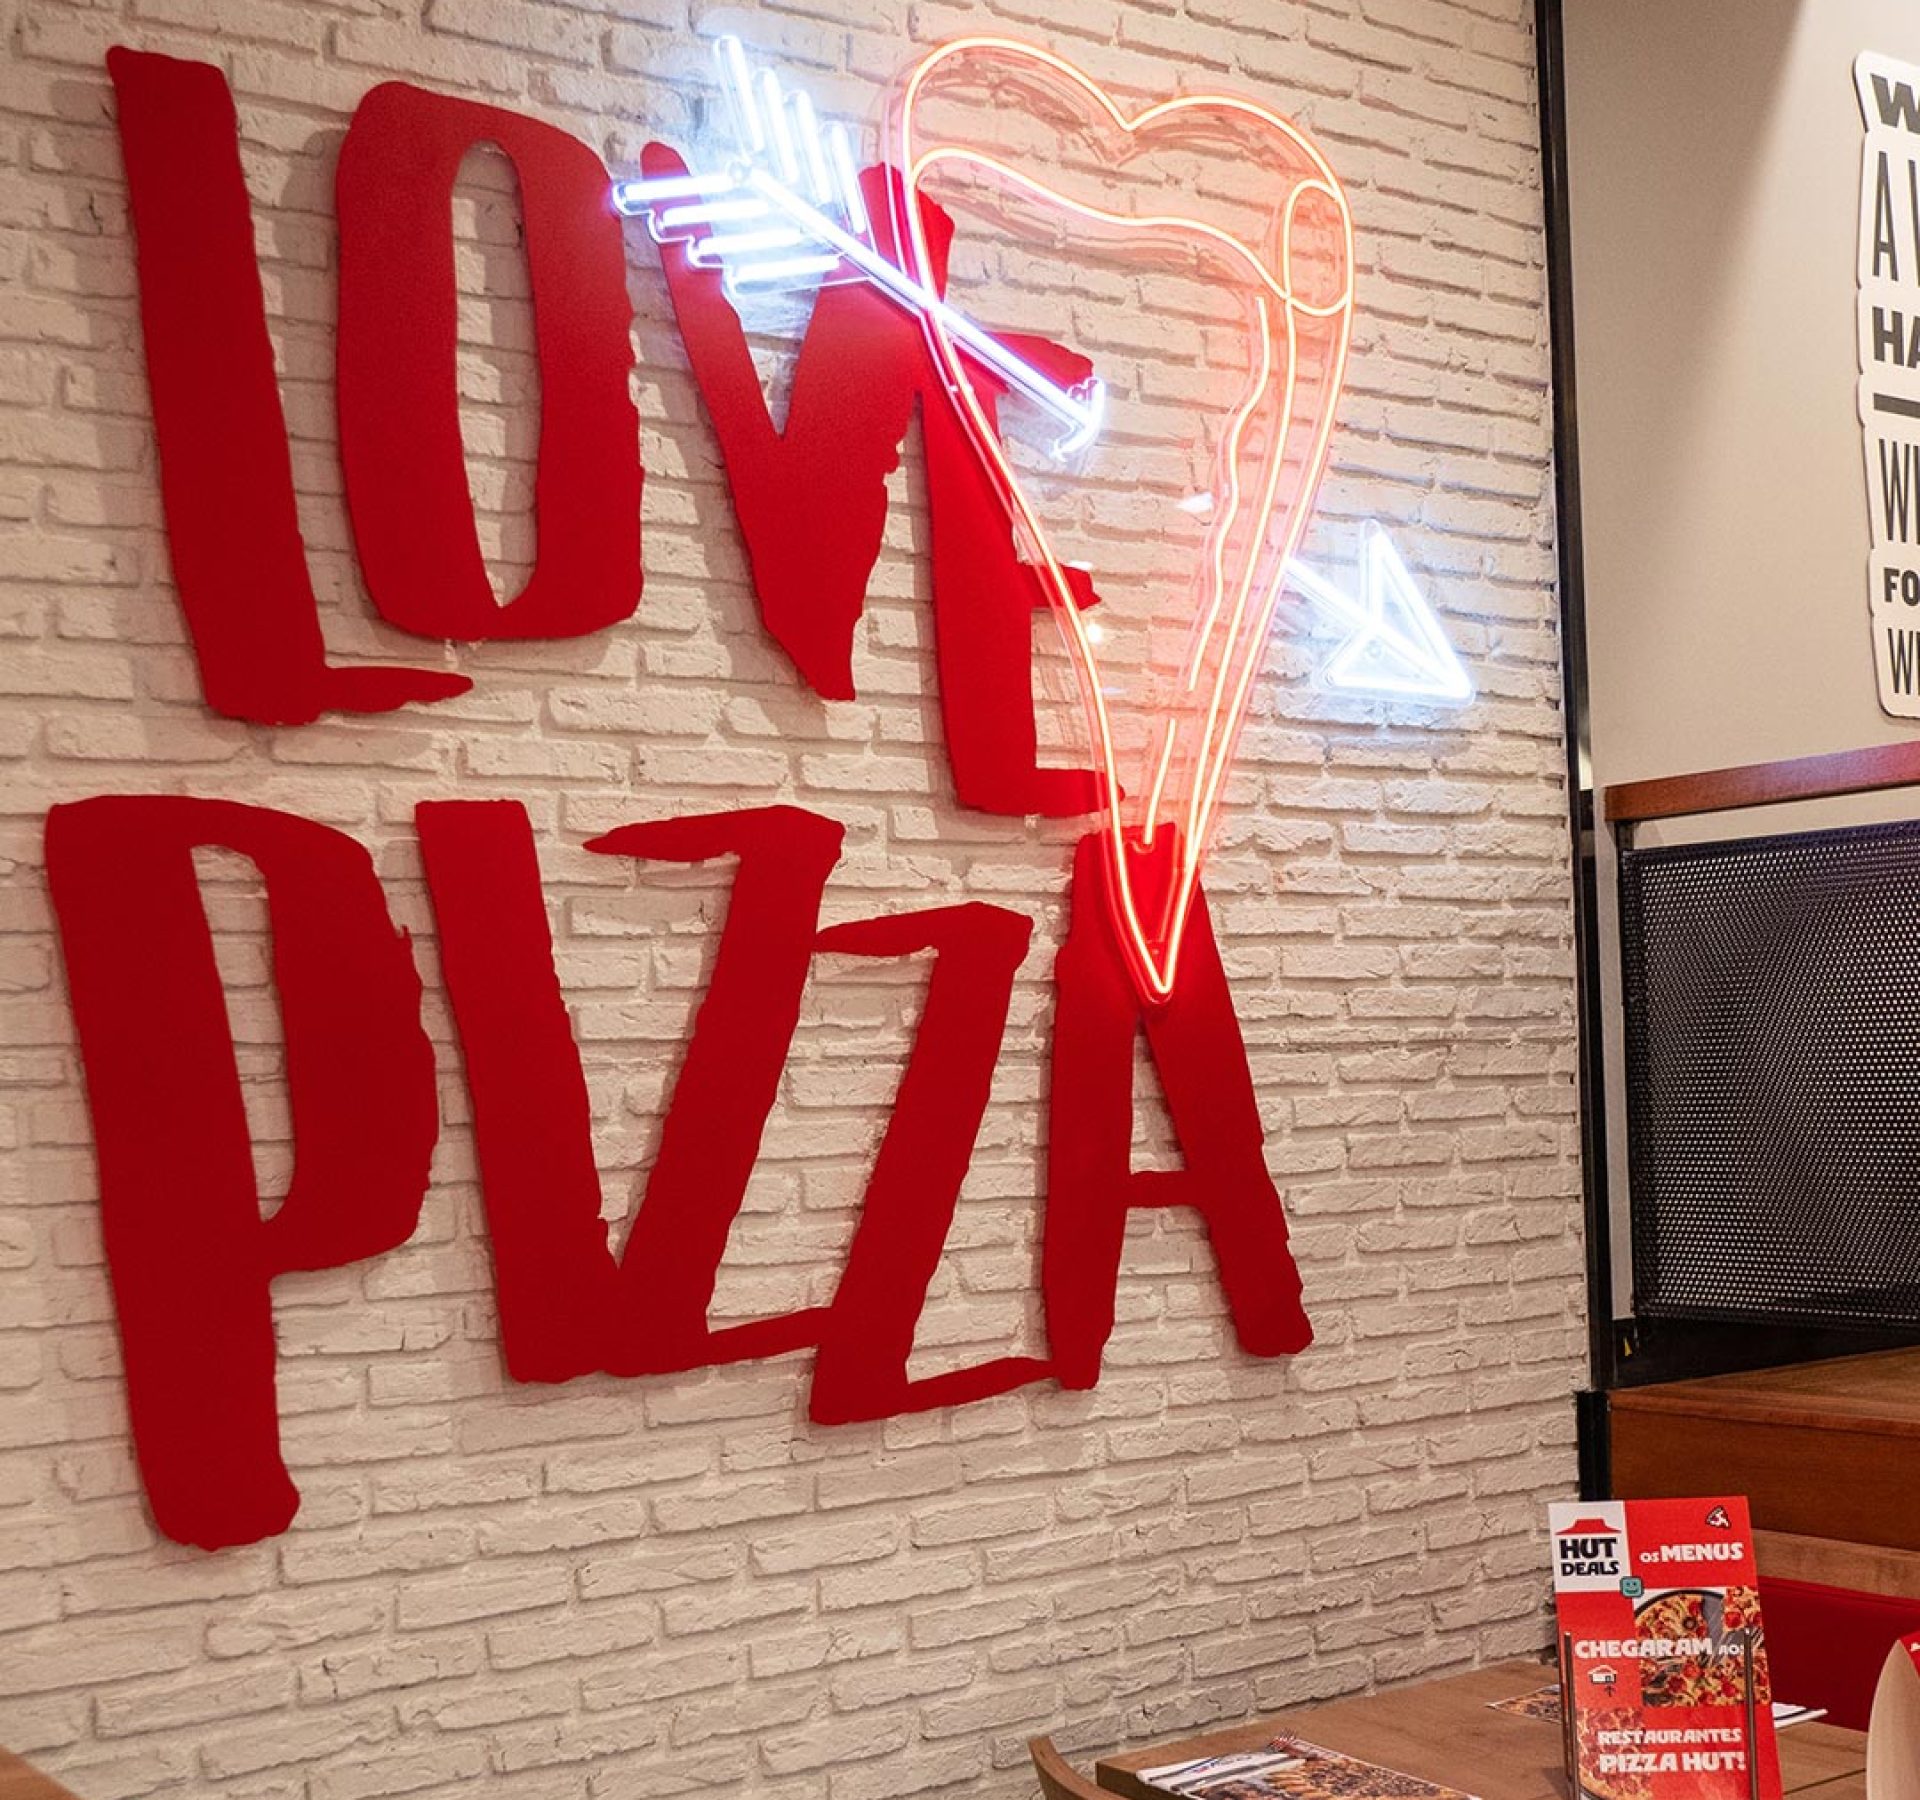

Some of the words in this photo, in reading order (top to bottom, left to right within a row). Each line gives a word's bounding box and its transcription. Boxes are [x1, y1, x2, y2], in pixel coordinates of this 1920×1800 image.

[106, 45, 1125, 816] LOVE
[45, 794, 1314, 1550] PIZZA
[1559, 1537, 1617, 1559] HUT
[1660, 1543, 1743, 1562] MENUS
[1561, 1561, 1620, 1576] DEALS
[1574, 1638, 1713, 1658] CHEGARAM
[1598, 1729, 1742, 1745] RESTAURANTES
[1600, 1754, 1678, 1773] PIZZA
[1682, 1752, 1746, 1772] HUT!
